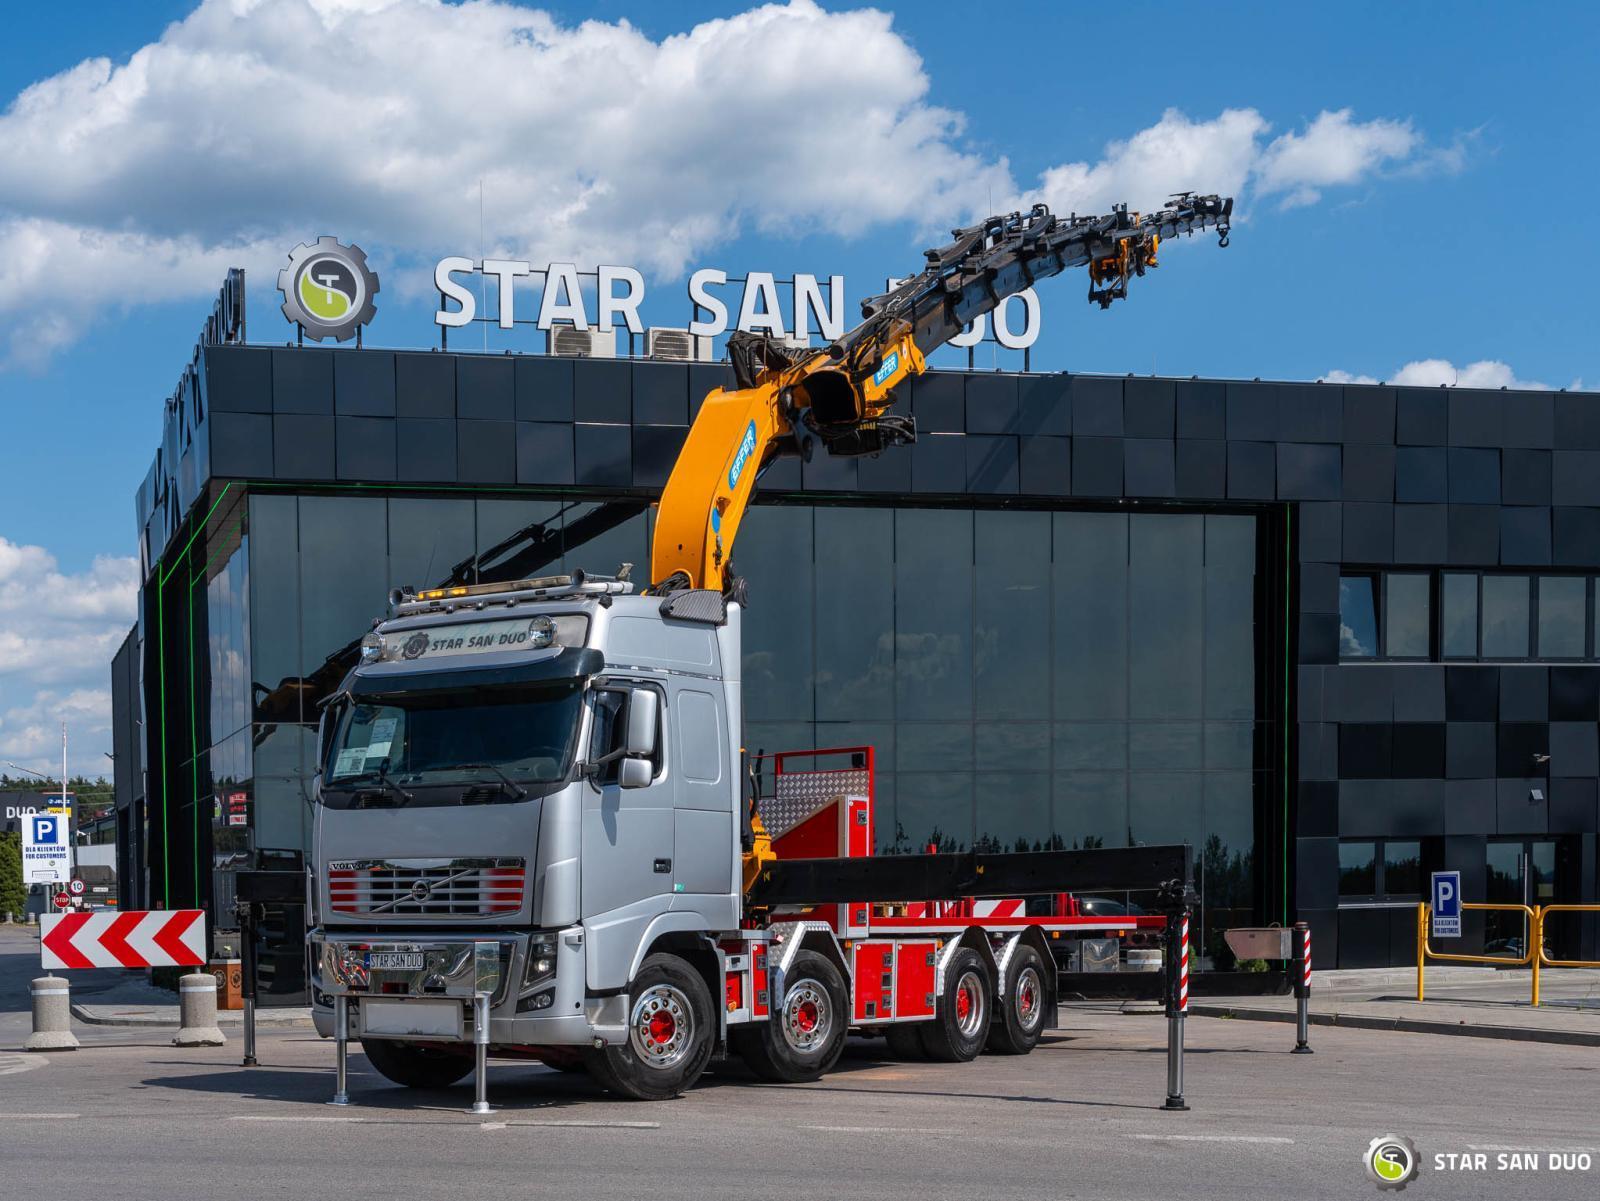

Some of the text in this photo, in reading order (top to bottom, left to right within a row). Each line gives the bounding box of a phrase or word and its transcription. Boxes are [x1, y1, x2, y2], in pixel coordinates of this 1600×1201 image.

[434, 256, 645, 334] STAR
[687, 267, 845, 342] SAN
[731, 425, 755, 486] EFFER
[431, 632, 526, 651] STAR SAN DUO
[6, 806, 37, 819] DUO
[37, 820, 53, 841] P
[36, 852, 67, 860] CUSTOMERS
[332, 862, 365, 871] VOLVO
[73, 882, 83, 890] 10
[1438, 881, 1454, 912] P
[371, 953, 422, 968] STAR SAN DUO
